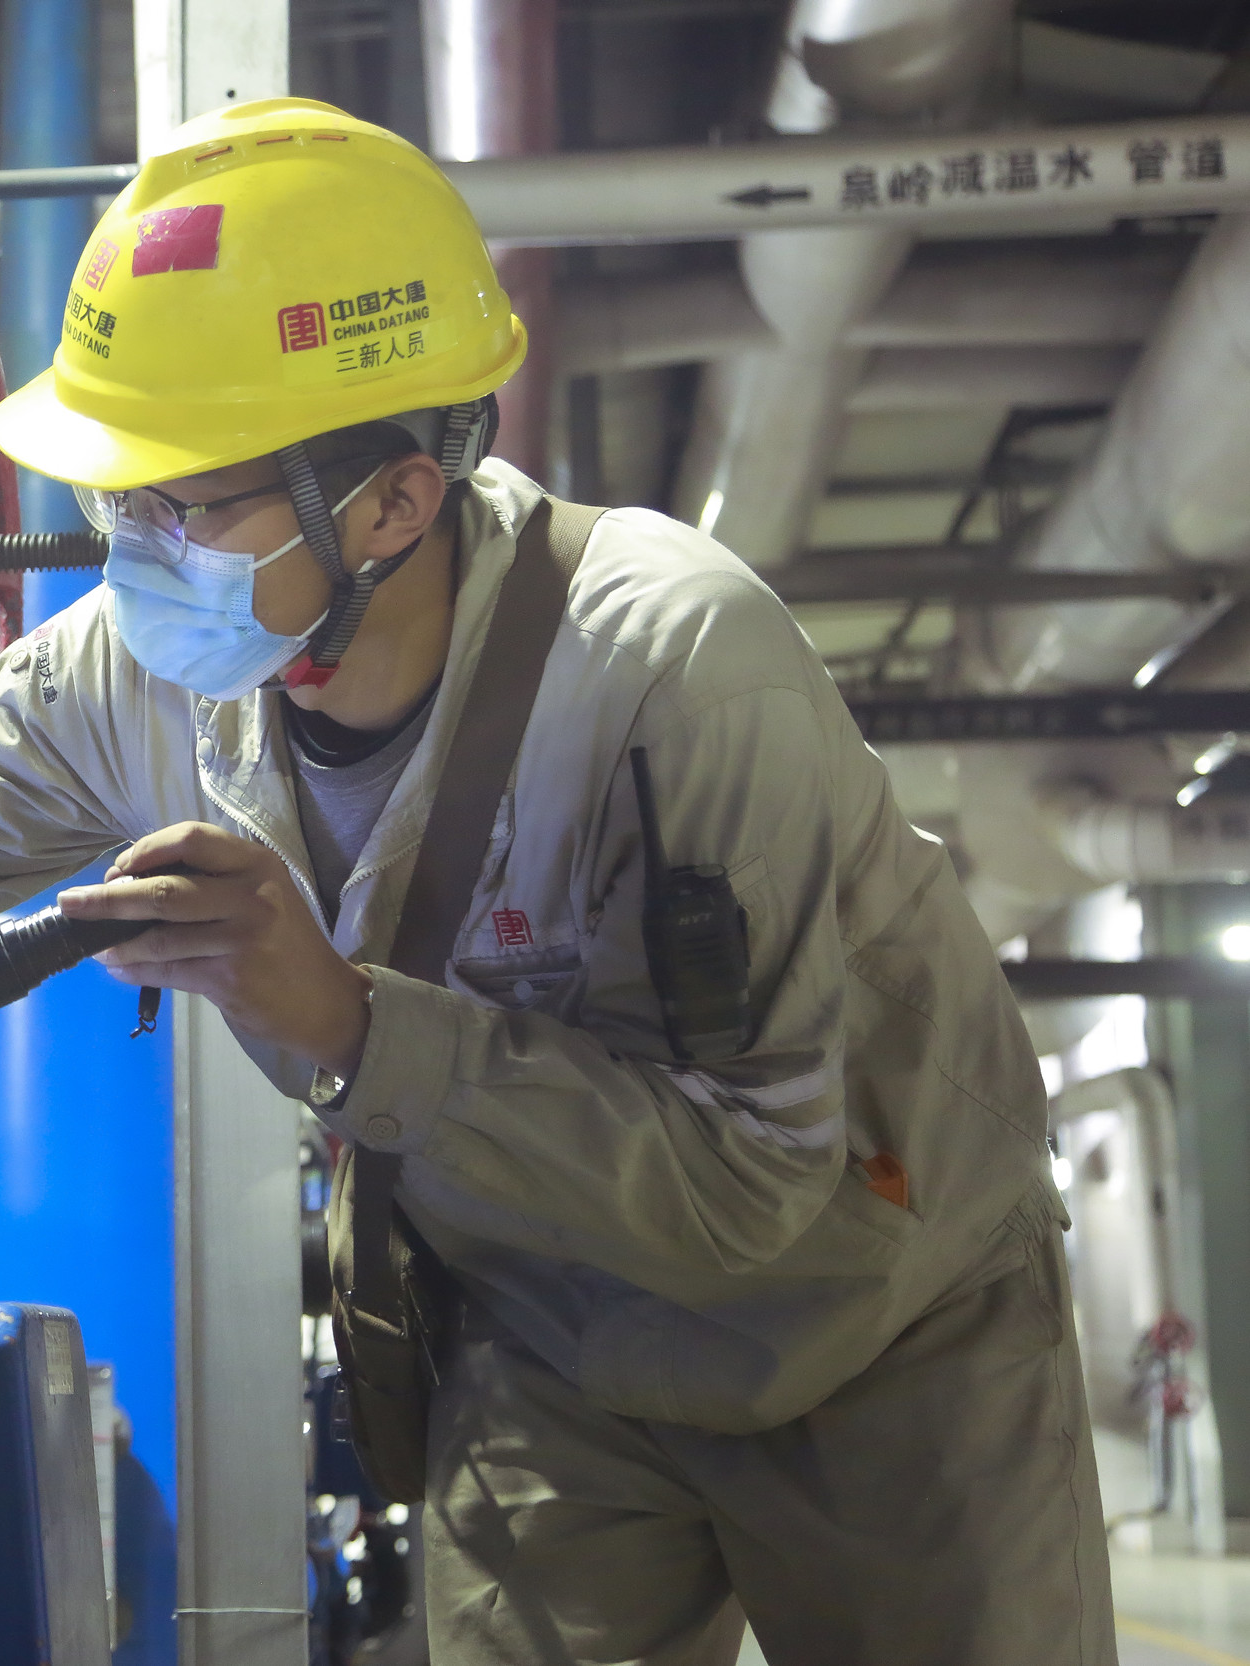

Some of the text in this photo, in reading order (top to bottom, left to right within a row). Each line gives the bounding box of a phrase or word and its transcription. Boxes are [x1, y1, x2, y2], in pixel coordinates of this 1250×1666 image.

[1126, 137, 1227, 183] 管道
[329, 280, 427, 321] 中国大唐
[72, 327, 111, 359] DATANG
[333, 306, 430, 341] CHINA DATANG
[336, 330, 425, 372] 三新人员
[36, 641, 58, 704] 中国大唐
